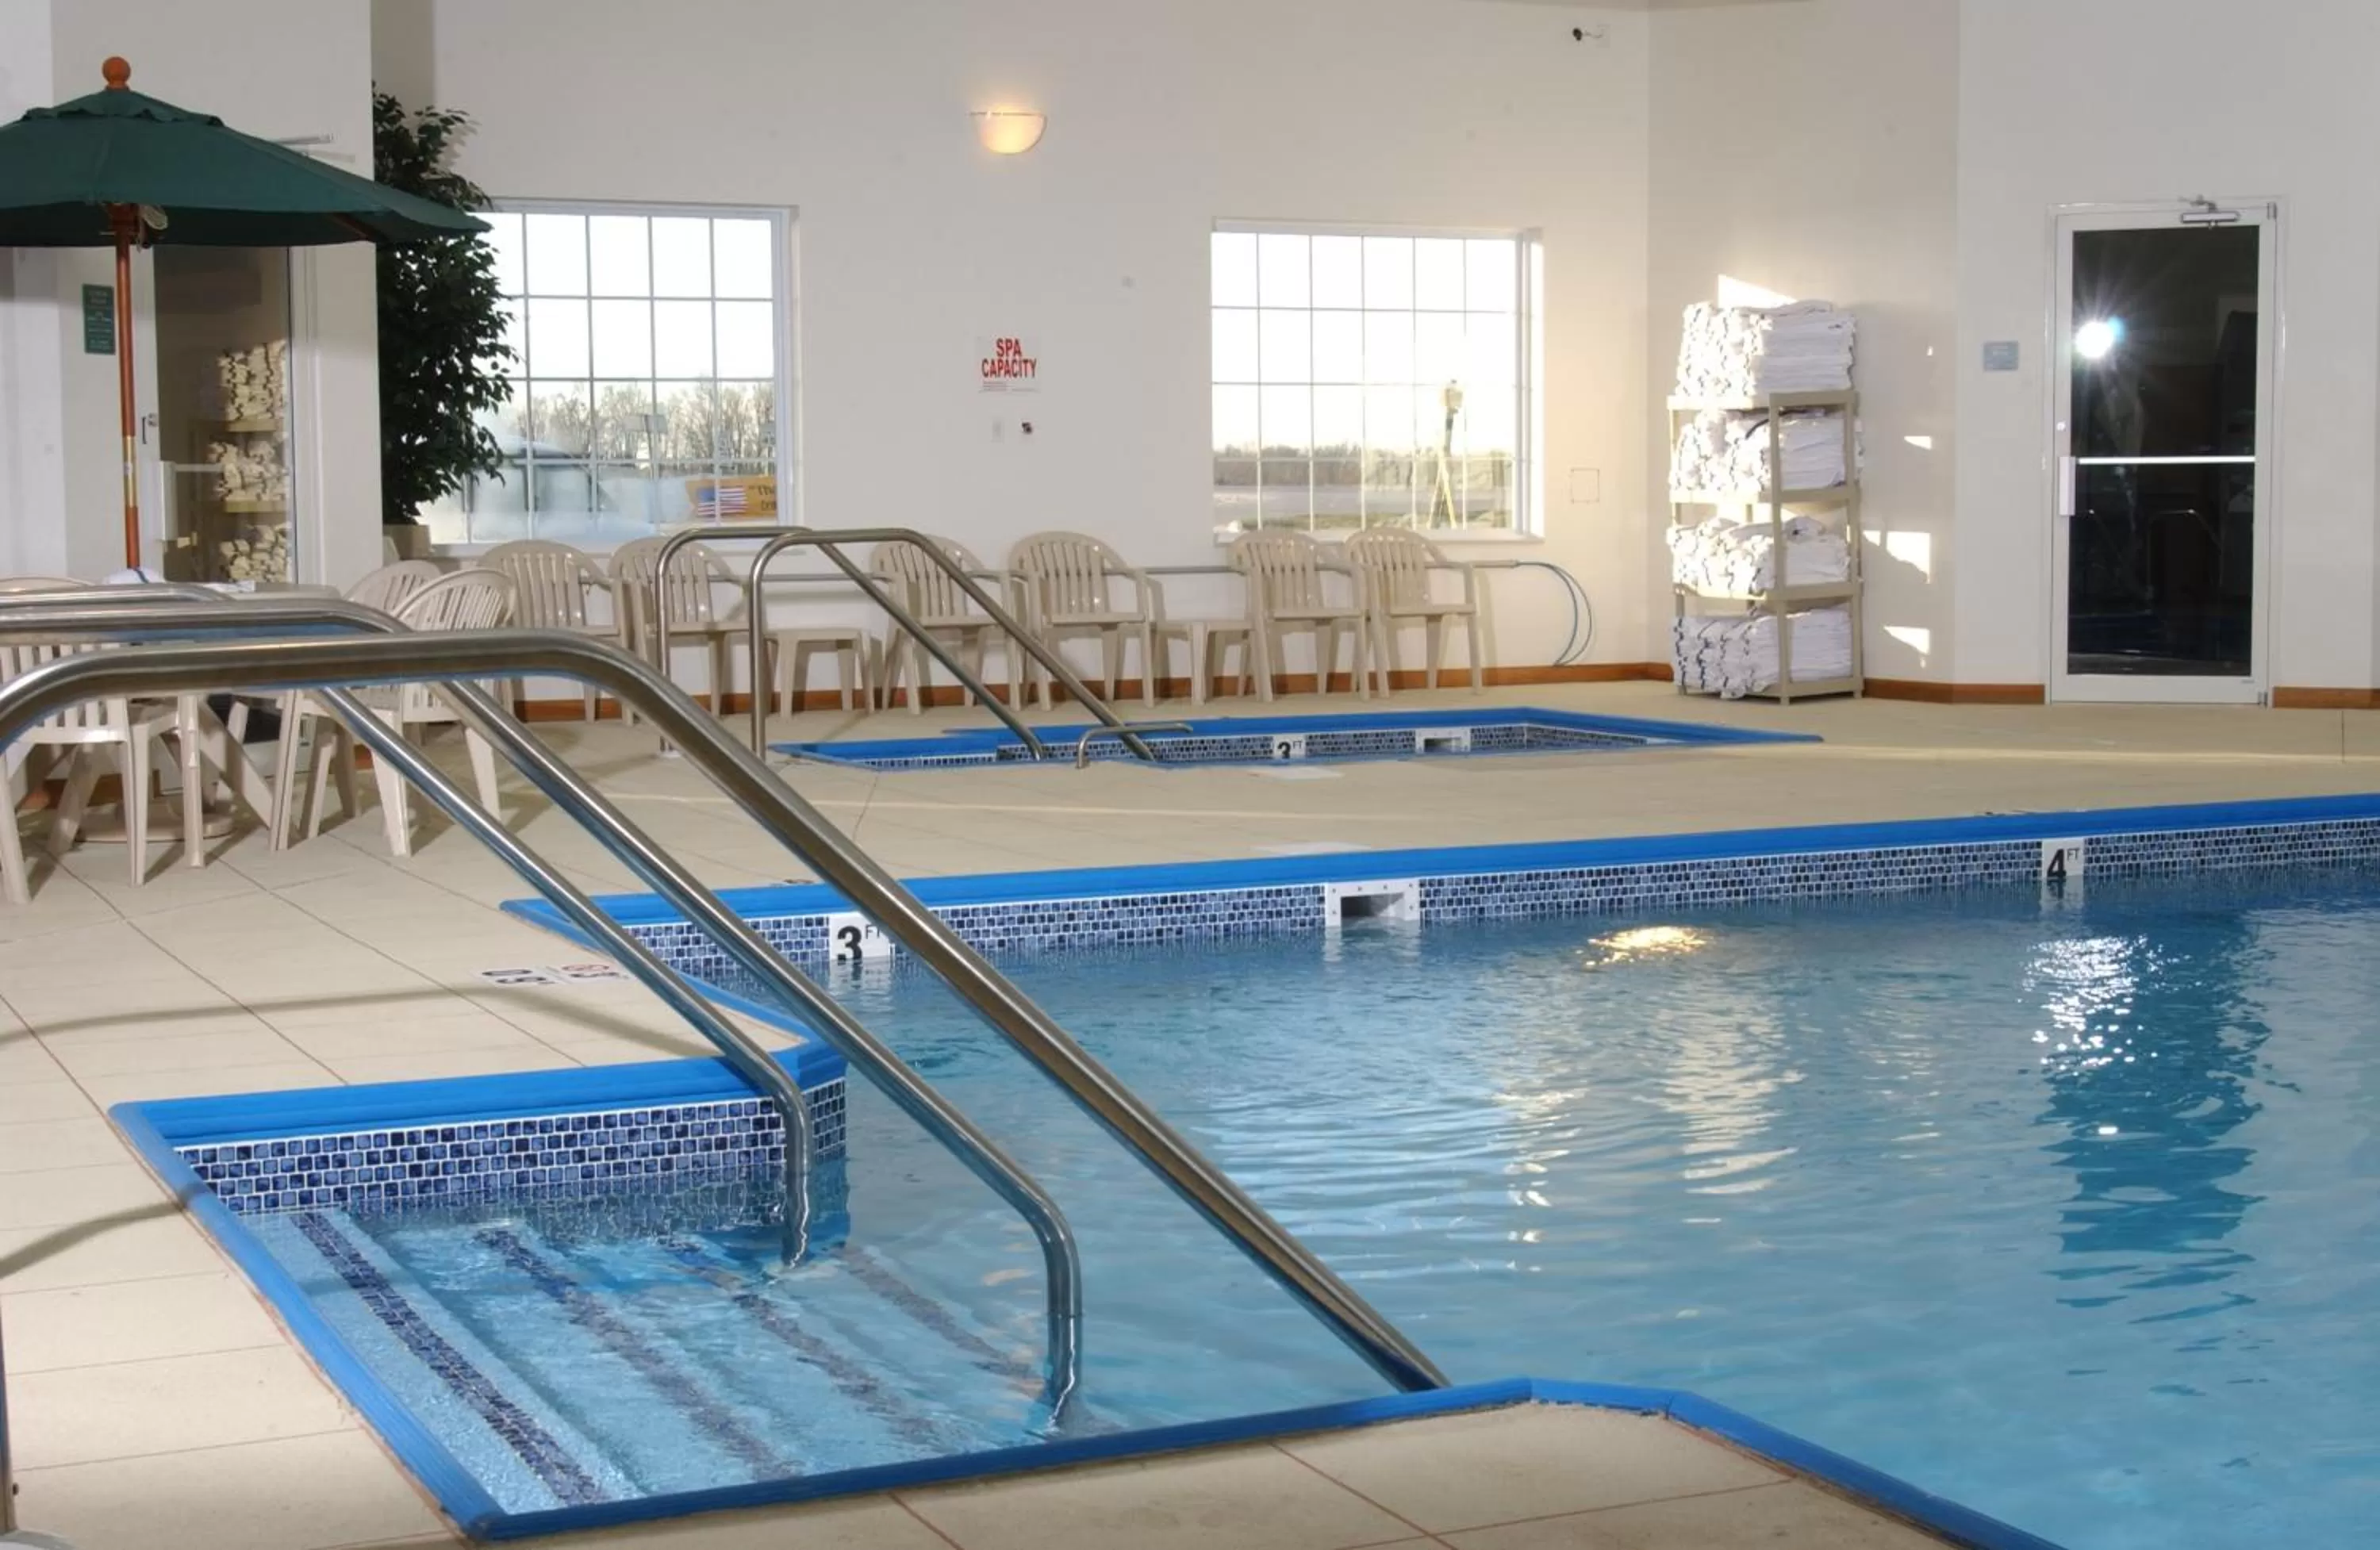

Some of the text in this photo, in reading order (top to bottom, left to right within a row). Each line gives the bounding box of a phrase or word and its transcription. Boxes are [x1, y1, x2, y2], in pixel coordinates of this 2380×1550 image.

[996, 337, 1023, 357] SPA
[981, 358, 1037, 378] CAPACITY
[2047, 848, 2067, 877] 4
[837, 925, 863, 962] 3
